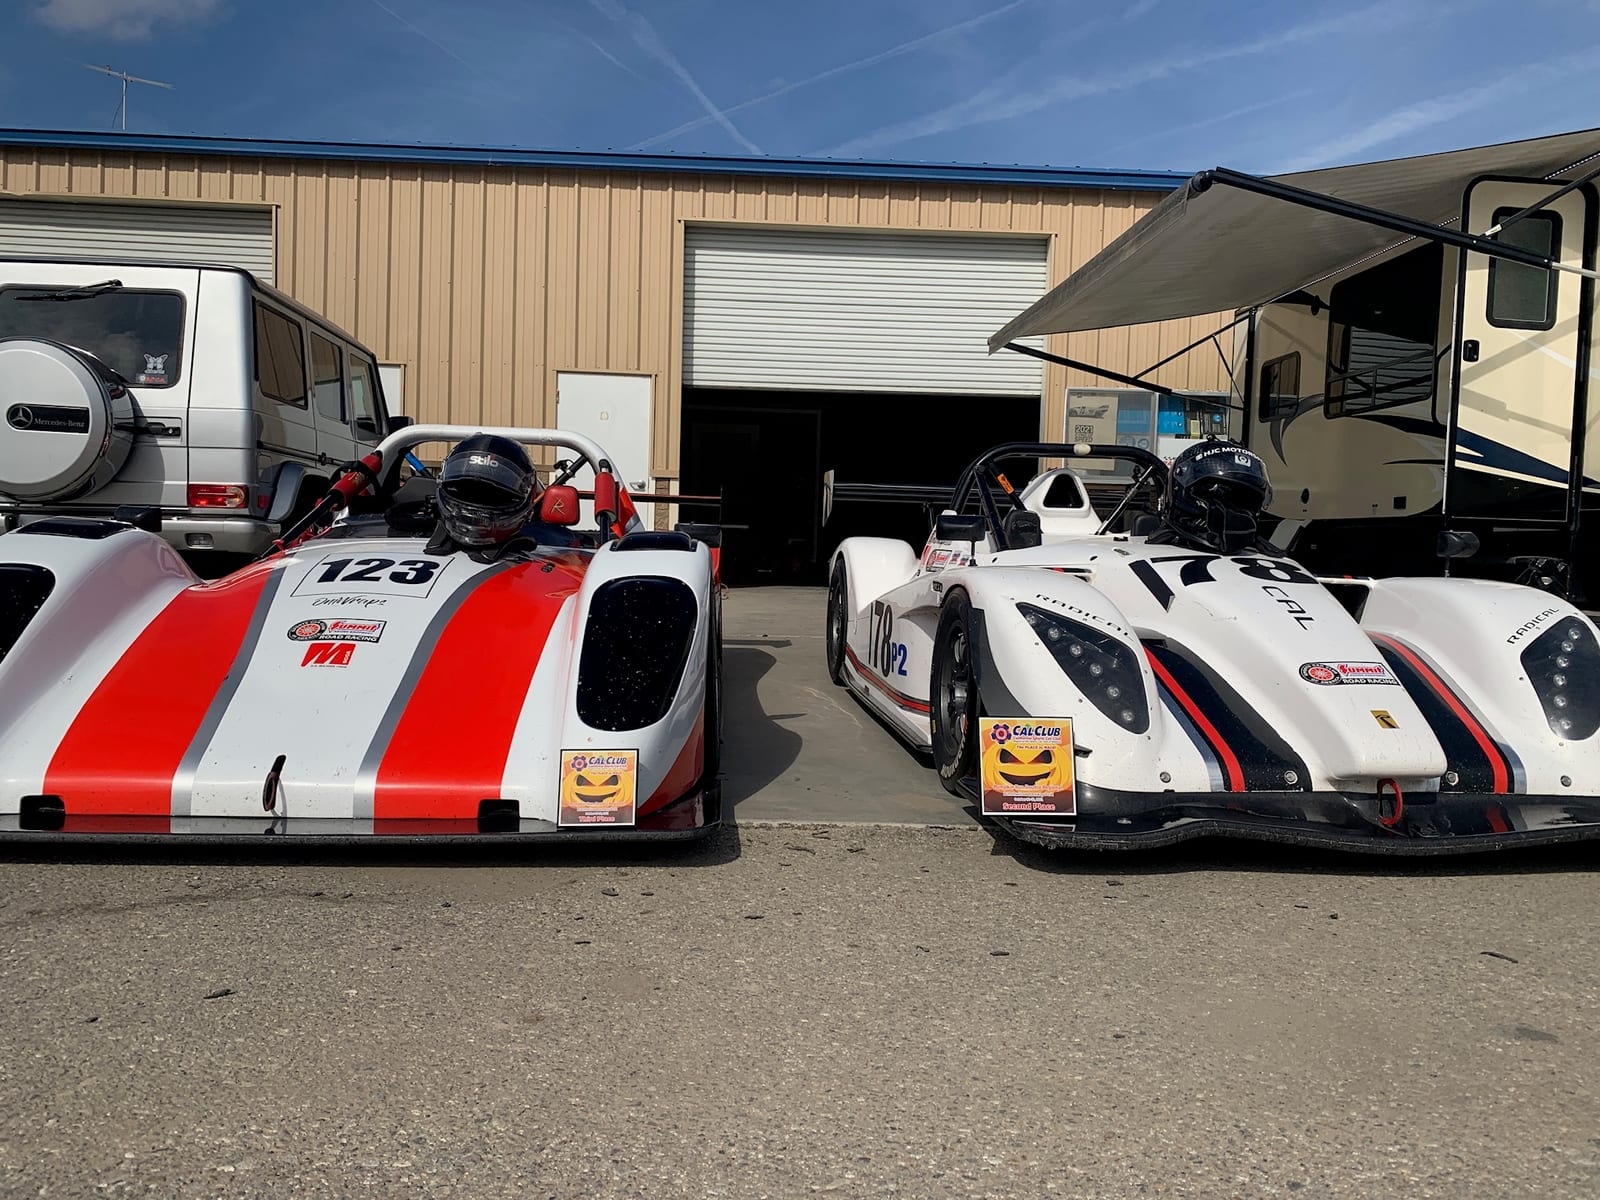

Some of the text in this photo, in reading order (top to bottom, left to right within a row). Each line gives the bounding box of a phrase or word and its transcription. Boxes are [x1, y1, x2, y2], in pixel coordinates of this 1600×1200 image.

[33, 417, 86, 429] Mercedes-Benz
[468, 454, 499, 468] Stilo
[1203, 447, 1221, 457] HJC
[317, 558, 440, 585] 123
[1128, 555, 1320, 613] 178
[1036, 594, 1134, 642] RADICAL
[1261, 586, 1317, 631] CAL
[1506, 608, 1560, 645] RADICAL
[868, 599, 893, 678] 178
[891, 642, 908, 677] P2
